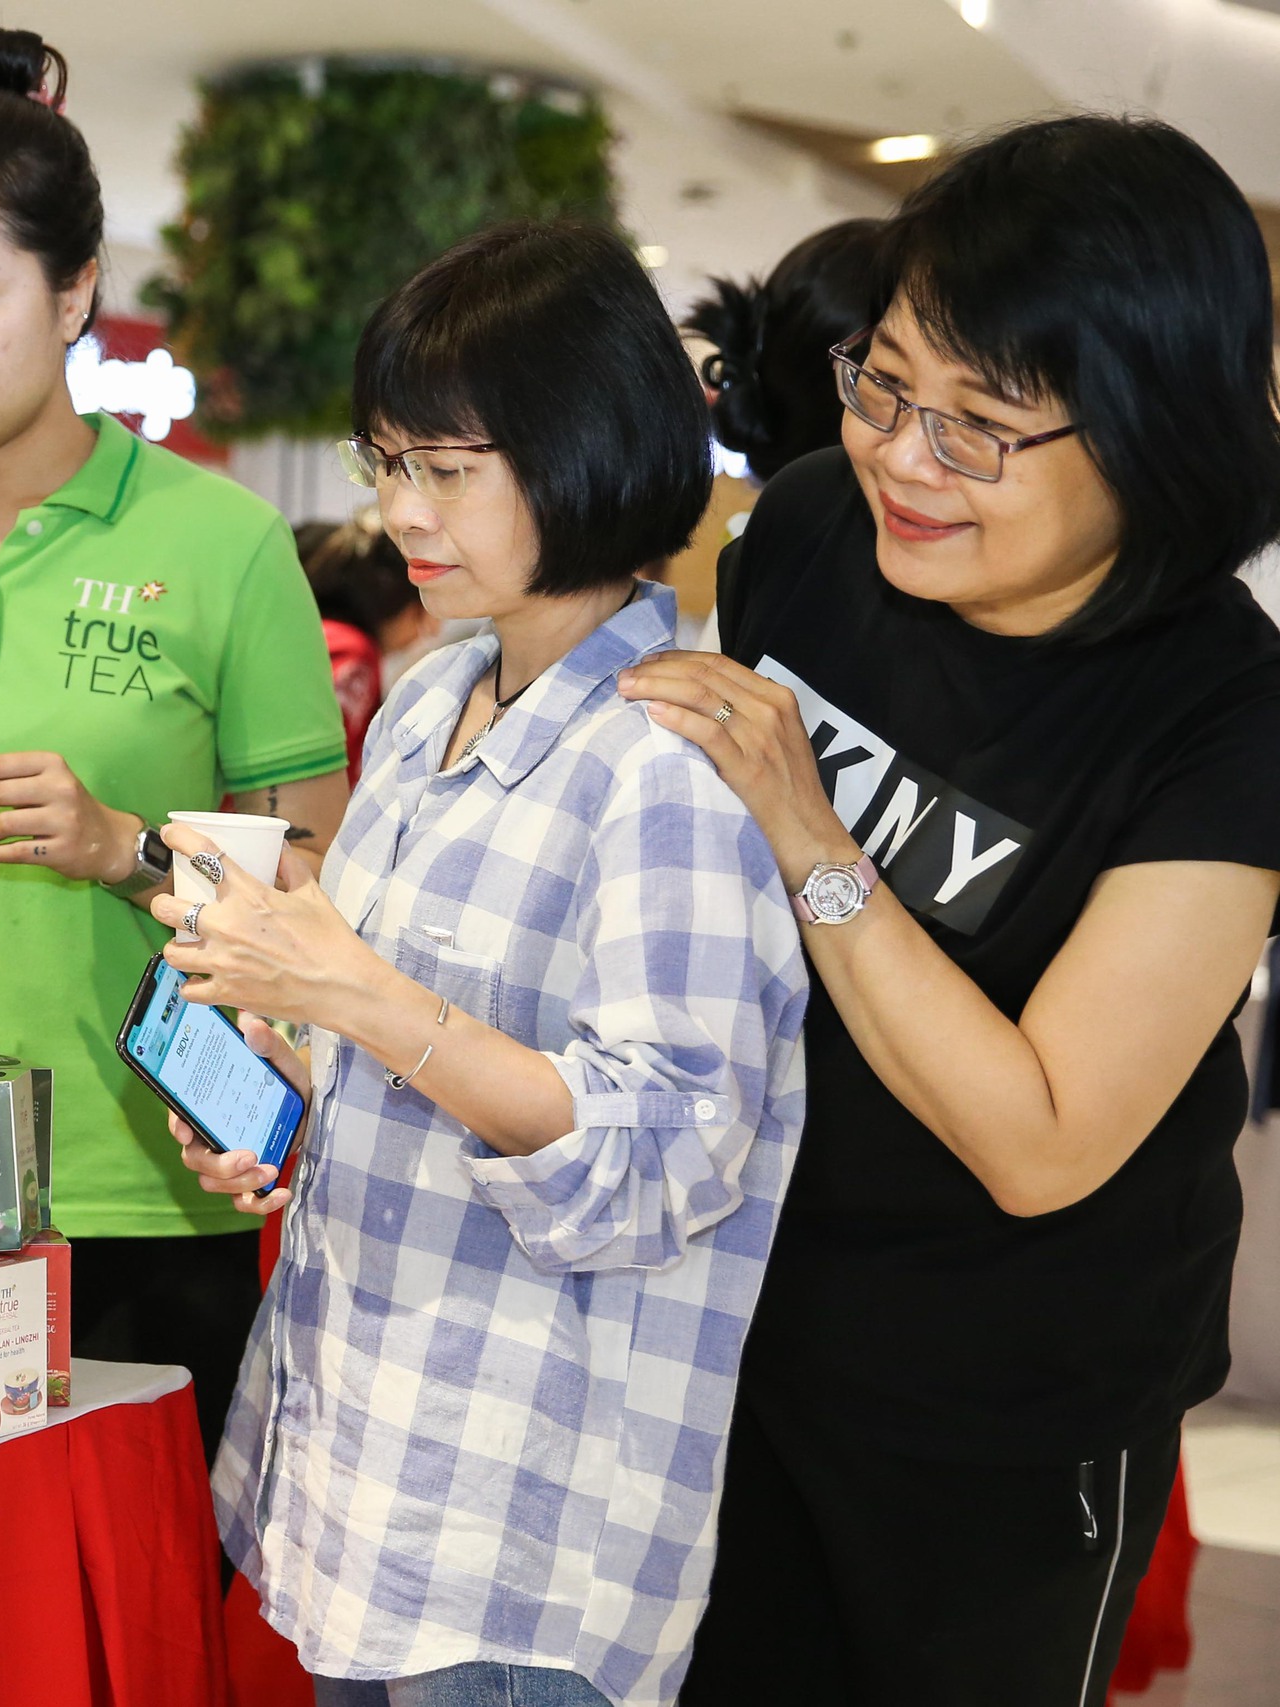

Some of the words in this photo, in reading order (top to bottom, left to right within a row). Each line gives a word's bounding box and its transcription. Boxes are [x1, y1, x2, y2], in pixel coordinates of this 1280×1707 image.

[73, 577, 136, 615] TH
[64, 610, 161, 661] true
[58, 651, 153, 702] TEA
[800, 712, 1021, 904] KNY
[176, 1031, 190, 1058] BIDV
[0, 1300, 19, 1313] true
[1, 1288, 12, 1299] TH
[10, 1347, 25, 1356] health
[15, 1333, 40, 1345] LINGZHI
